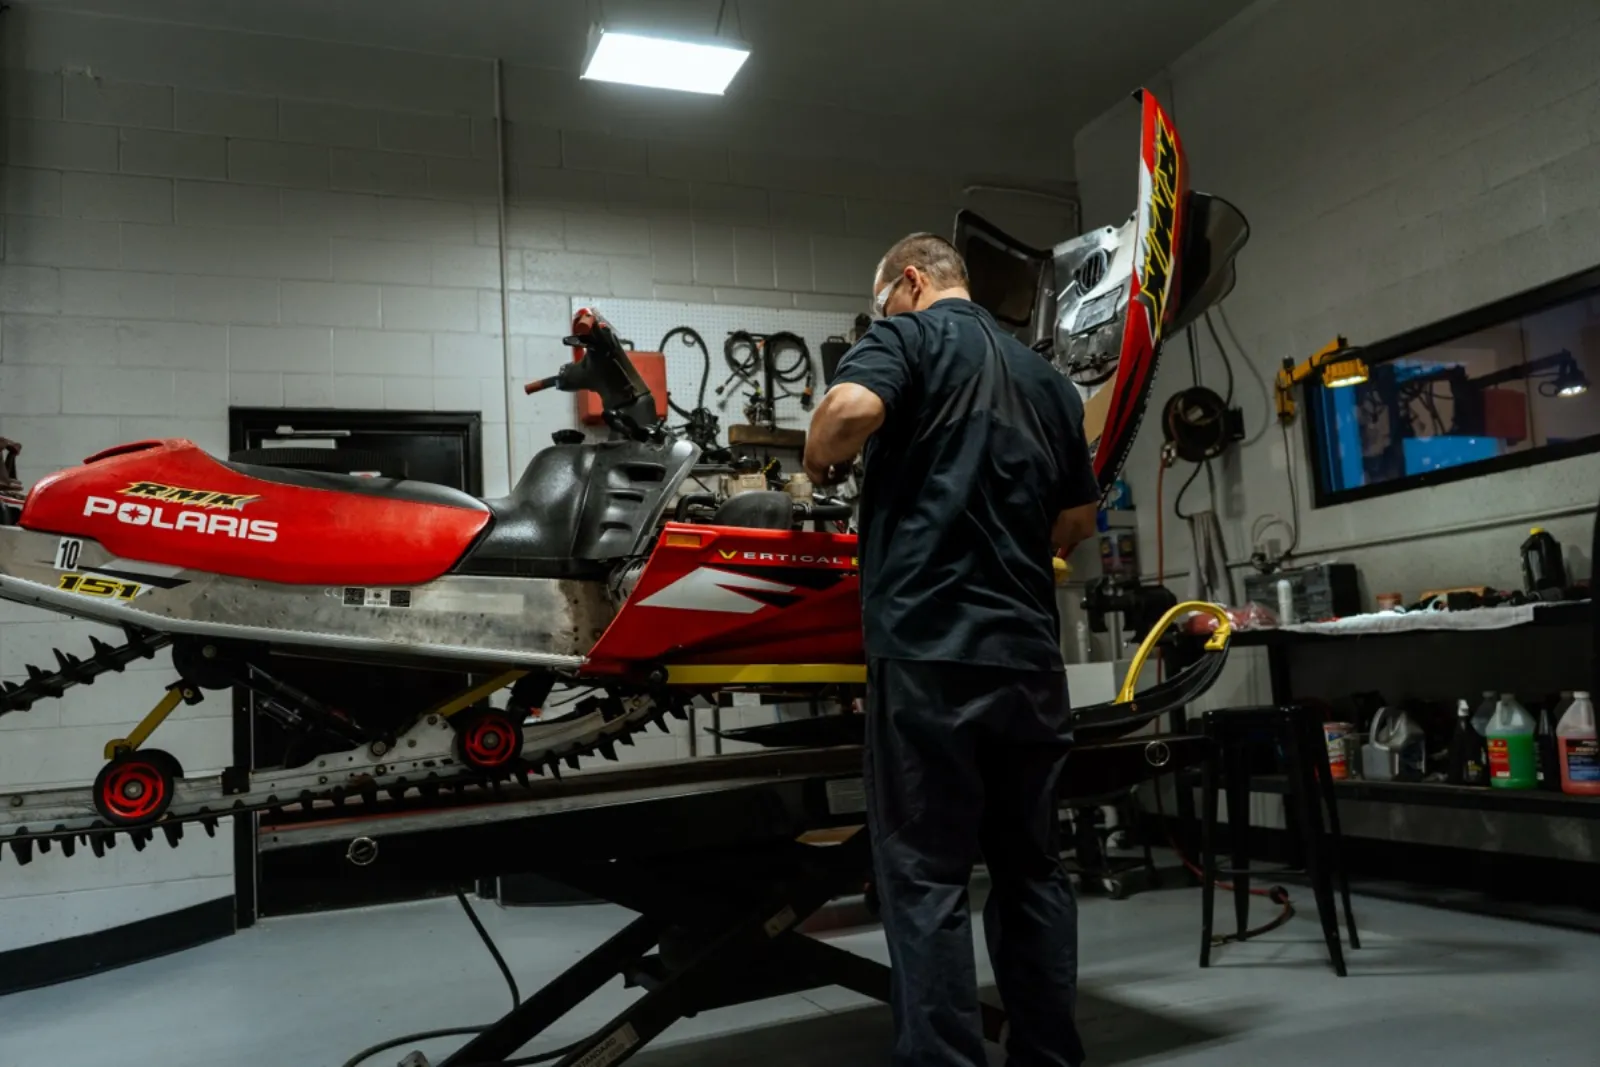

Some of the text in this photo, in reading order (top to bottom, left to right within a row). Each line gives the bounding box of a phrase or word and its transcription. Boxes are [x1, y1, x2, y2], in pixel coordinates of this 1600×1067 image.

[120, 481, 254, 510] RMK
[83, 496, 279, 543] POLARIS
[60, 539, 80, 569] 10
[718, 549, 843, 565] VERTICAL
[60, 574, 141, 601] 151
